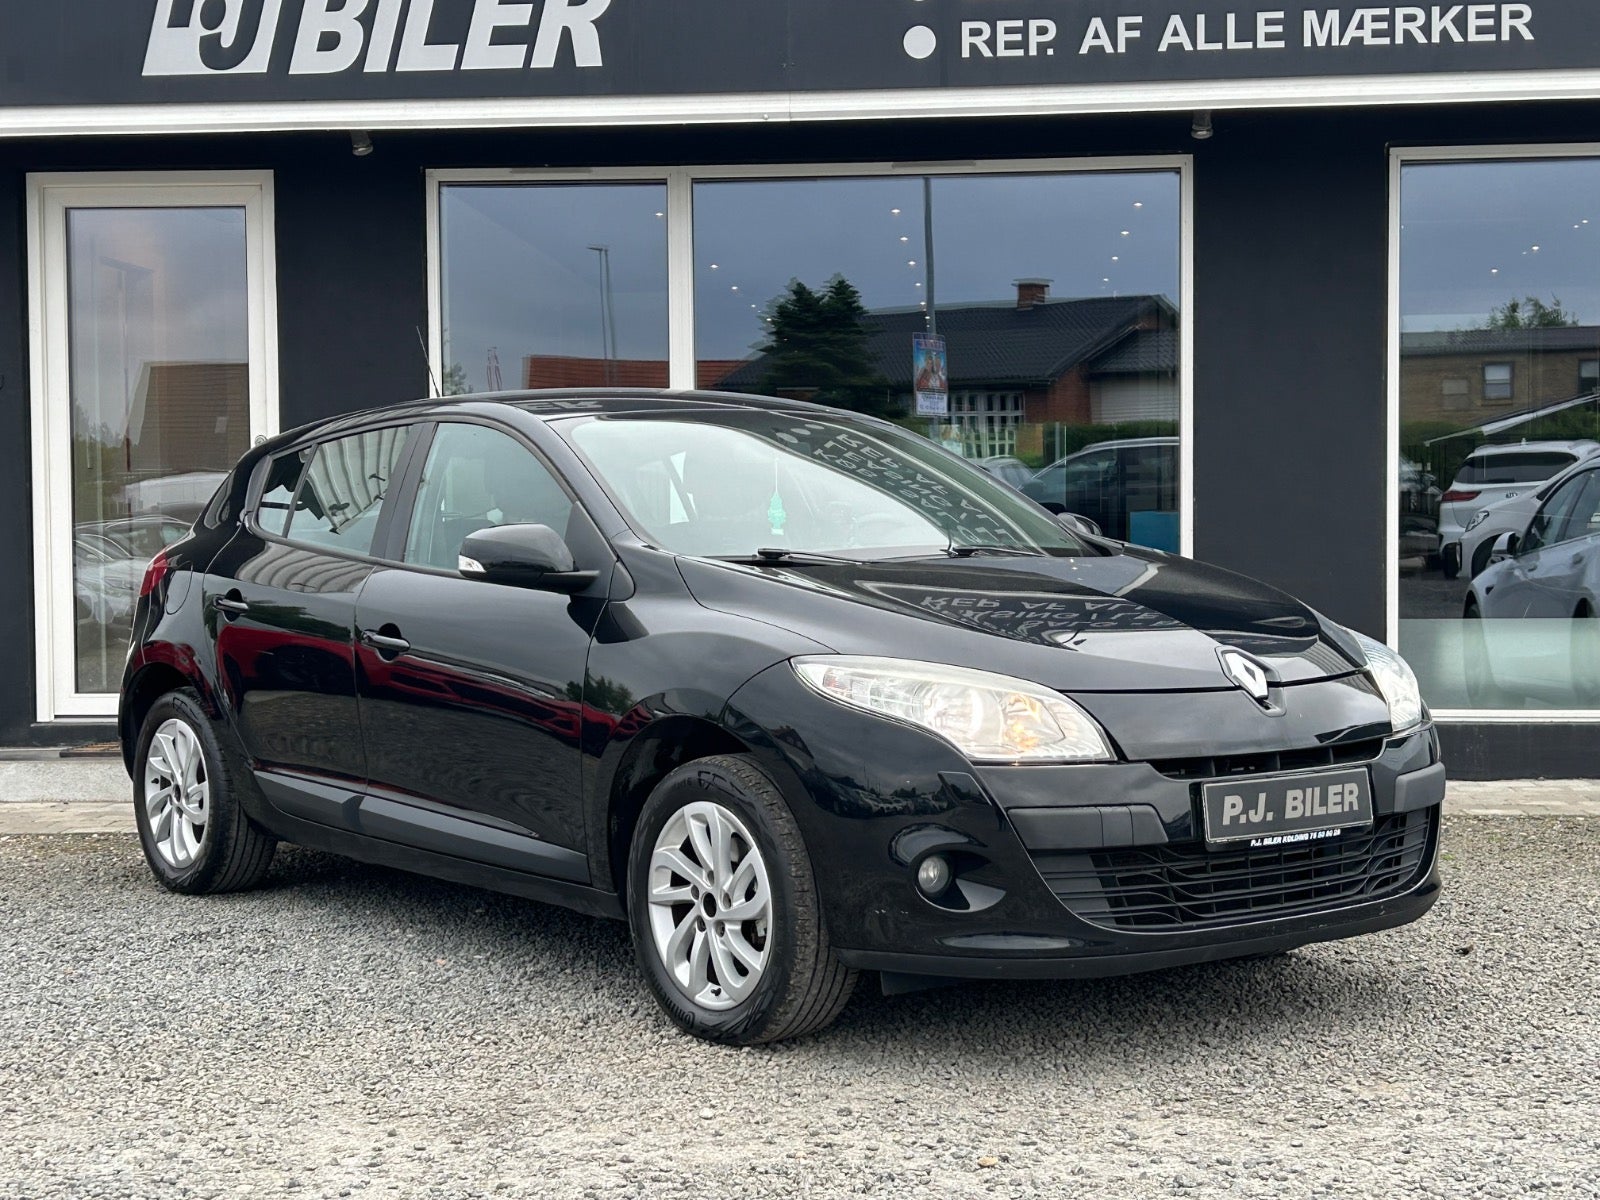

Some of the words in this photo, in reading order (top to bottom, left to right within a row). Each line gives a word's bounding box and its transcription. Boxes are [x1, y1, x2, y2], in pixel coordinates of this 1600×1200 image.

[288, 0, 612, 75] BILER
[961, 18, 1057, 58] REP.
[1078, 16, 1143, 54] AF
[1157, 11, 1286, 52] ALLE
[1303, 3, 1535, 47] MÆRKER
[1222, 792, 1274, 826] P.J.
[1284, 782, 1359, 819] BILER
[1263, 836, 1282, 845] BILER
